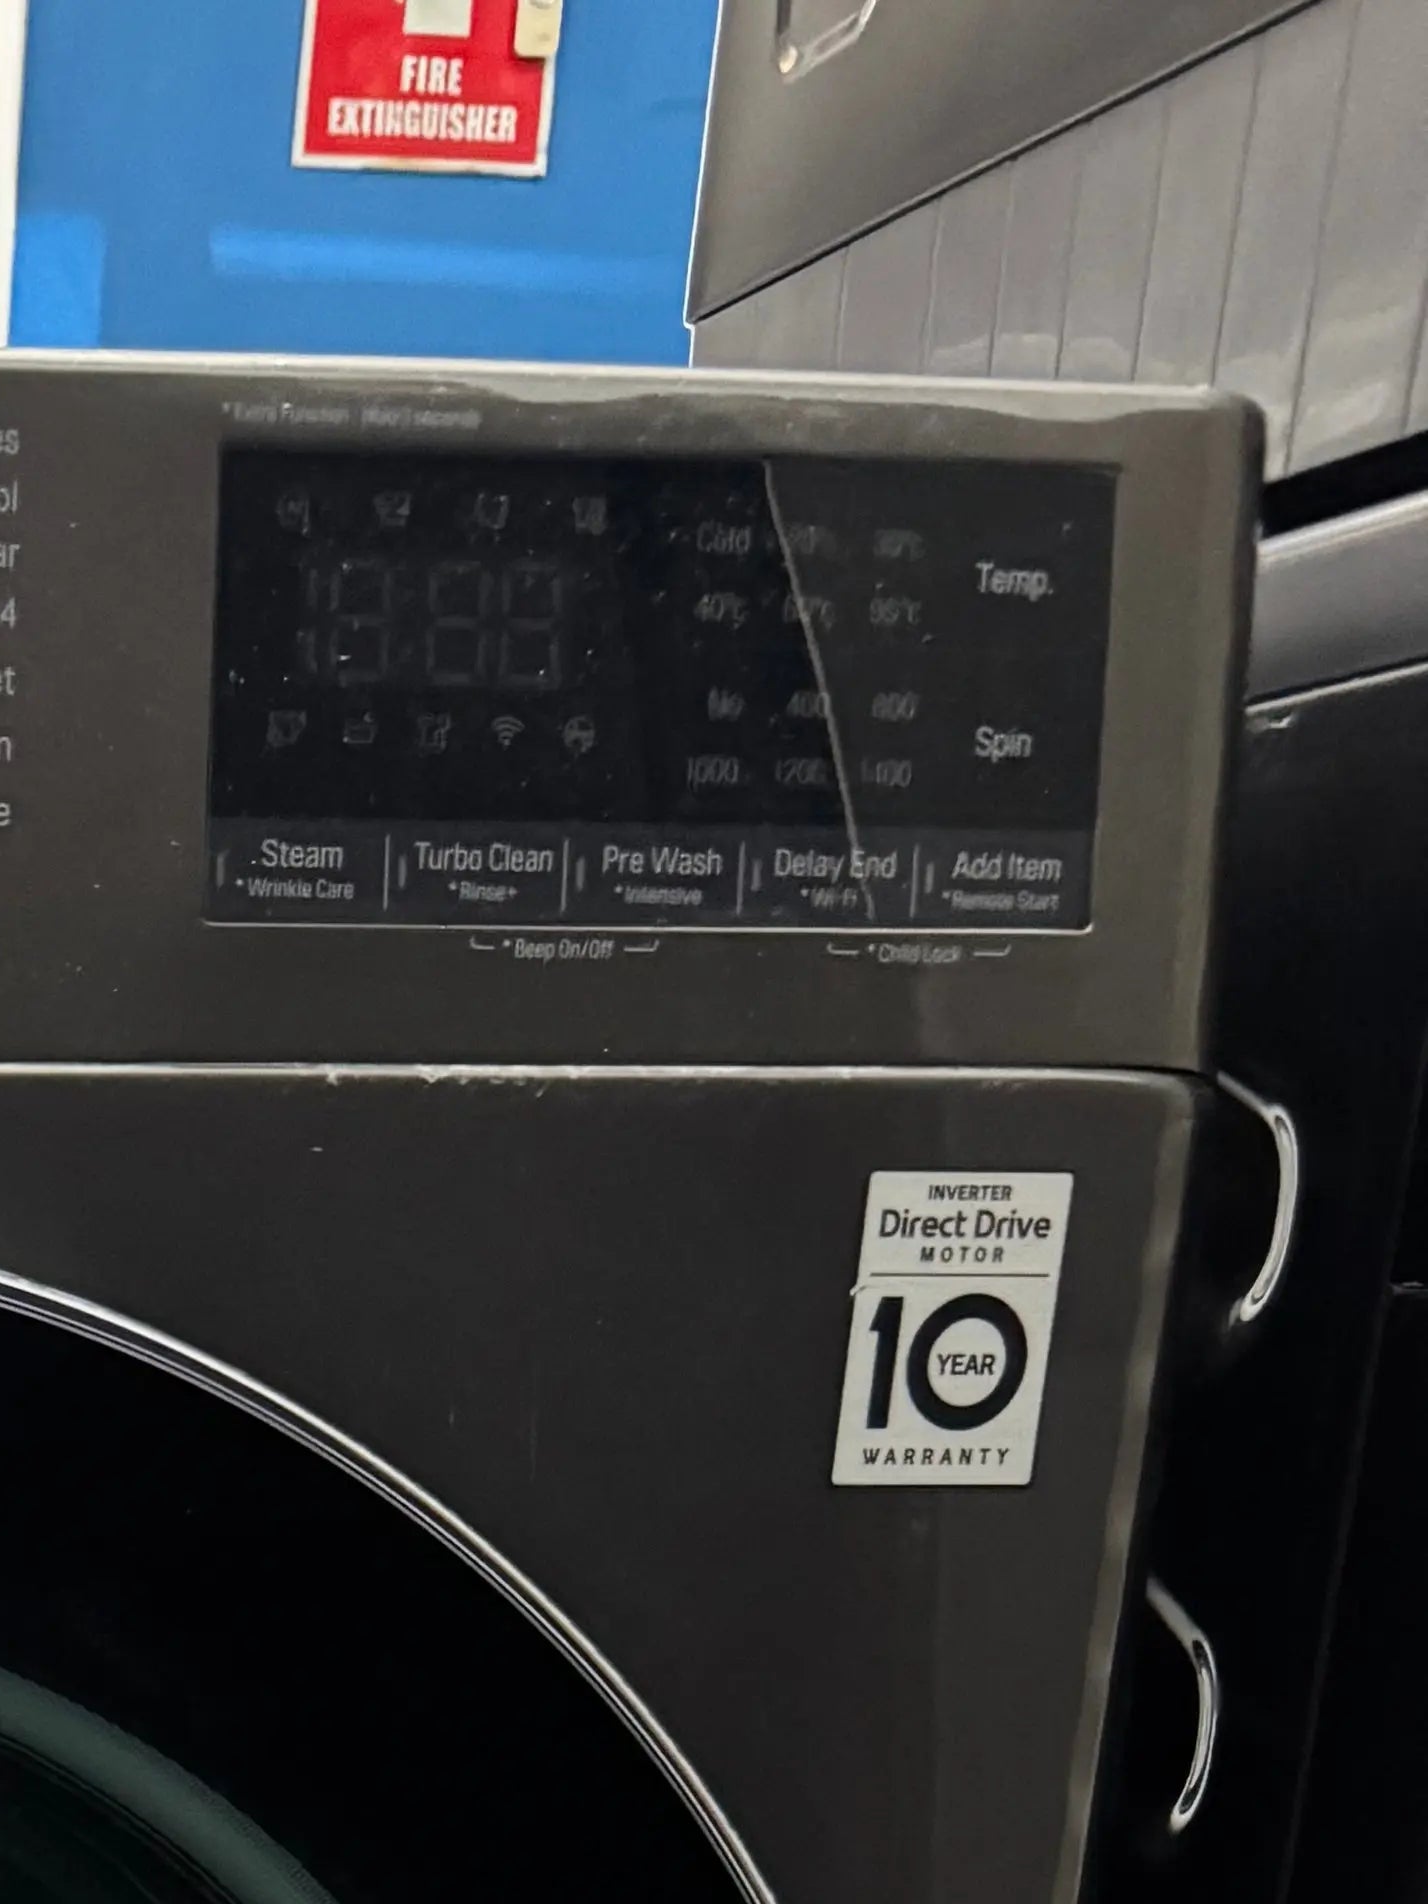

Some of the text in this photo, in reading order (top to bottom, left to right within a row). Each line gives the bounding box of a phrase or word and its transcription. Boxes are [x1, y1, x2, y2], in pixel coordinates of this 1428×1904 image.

[400, 55, 464, 96] FIRE
[327, 98, 517, 143] EXTINGUISHER
[976, 562, 1053, 601] Temp.
[975, 726, 1032, 762] Spin
[261, 838, 343, 870] Steam
[414, 840, 554, 873] Turbo Clean
[602, 845, 723, 876] Pre Wash
[774, 849, 896, 882] Delay End
[951, 851, 1062, 881] Add Item
[928, 1185, 1012, 1201] INVERTER
[879, 1209, 1051, 1239] Direct Drive
[920, 1247, 1004, 1263] MOTOR
[866, 1293, 1028, 1431] 10
[937, 1354, 995, 1376] YEAR
[862, 1448, 1010, 1466] WARRANTY
